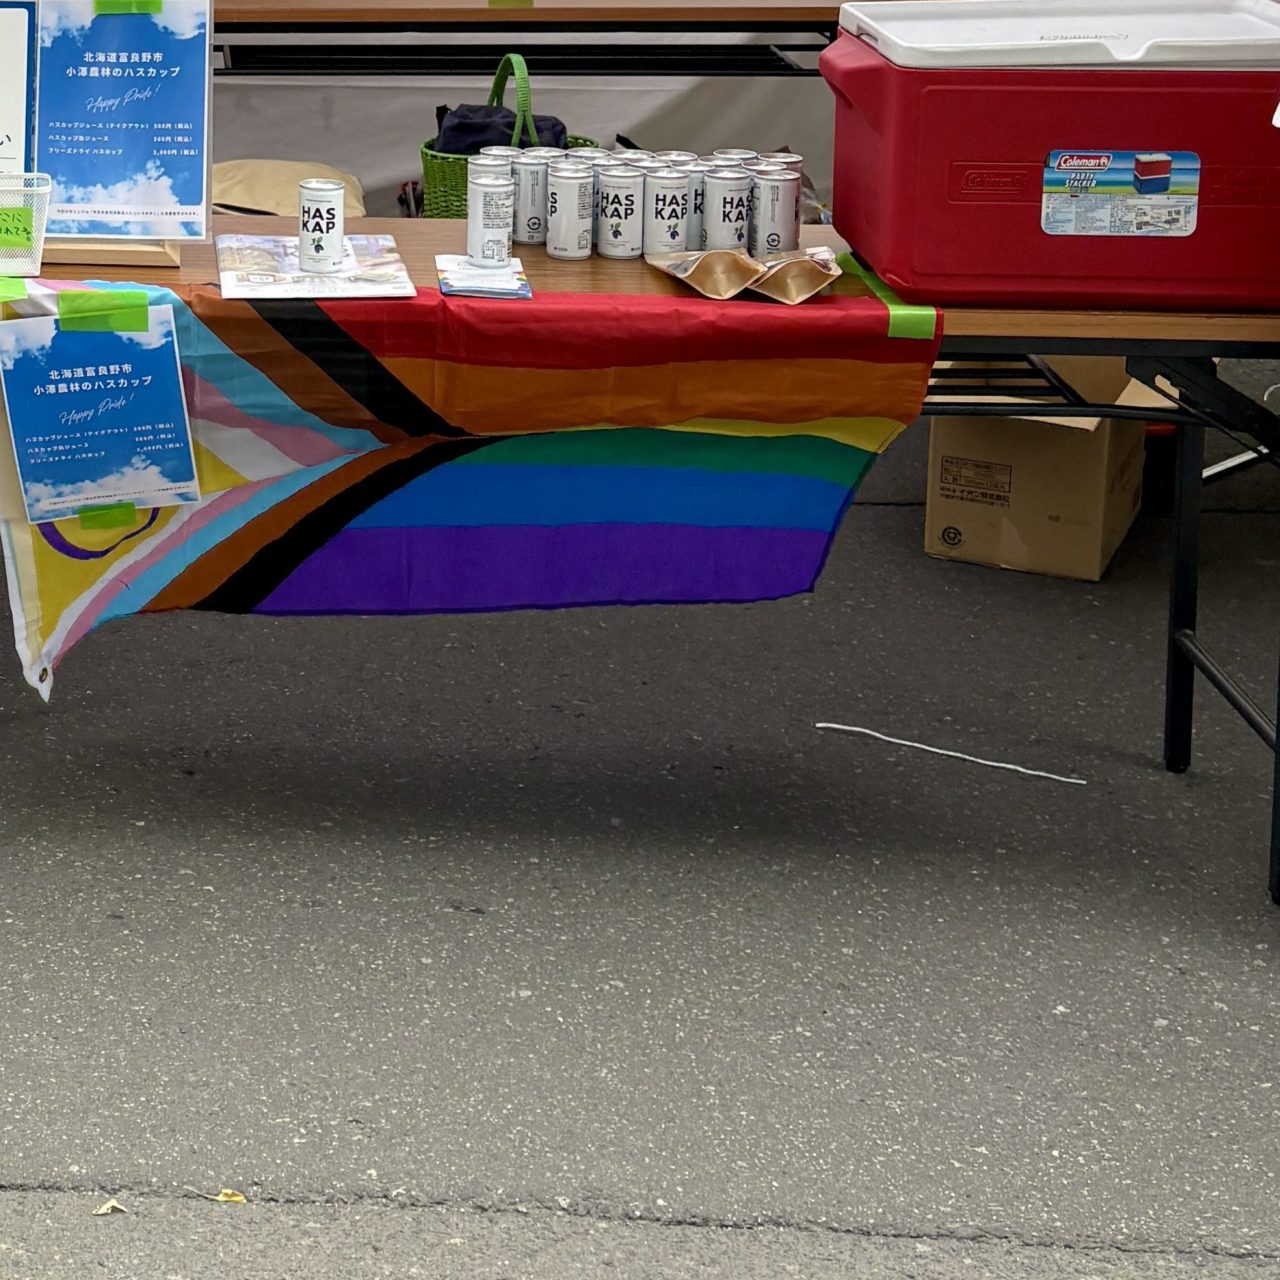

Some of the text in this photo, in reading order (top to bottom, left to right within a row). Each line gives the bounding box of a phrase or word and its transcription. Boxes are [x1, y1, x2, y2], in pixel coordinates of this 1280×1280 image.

[83, 52, 164, 63] 北海道富良野市
[85, 96, 121, 113] Happy
[1060, 155, 1100, 168] Coleman
[601, 193, 635, 207] HAS
[655, 194, 688, 207] HAS
[302, 205, 336, 220] HAS
[601, 206, 635, 220] KAP
[655, 208, 688, 220] KAP
[302, 220, 336, 235] KAP
[48, 363, 133, 381] 北海道富良野市
[59, 408, 94, 426] Happy
